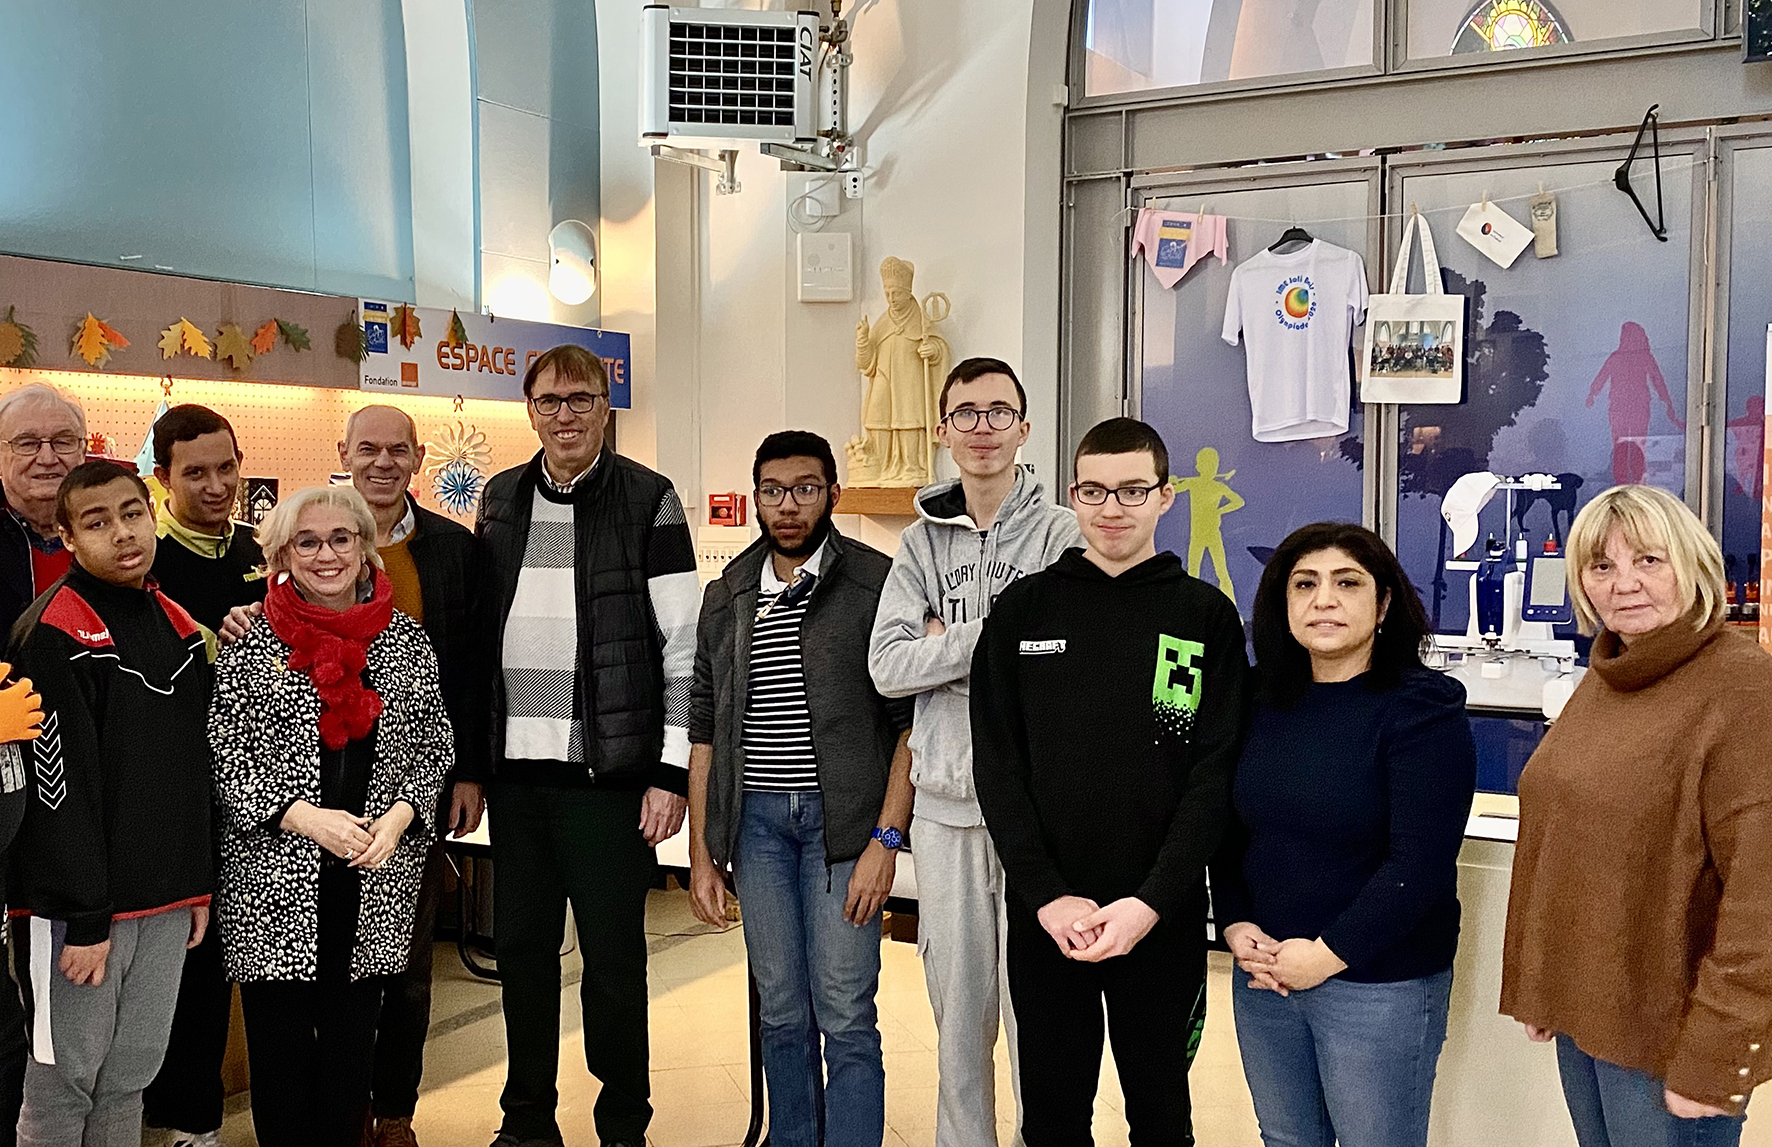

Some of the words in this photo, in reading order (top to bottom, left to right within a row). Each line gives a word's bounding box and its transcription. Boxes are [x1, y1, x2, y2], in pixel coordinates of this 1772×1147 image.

[799, 26, 814, 82] CIAT
[437, 341, 516, 376] ESPACE
[364, 375, 398, 387] Fondation
